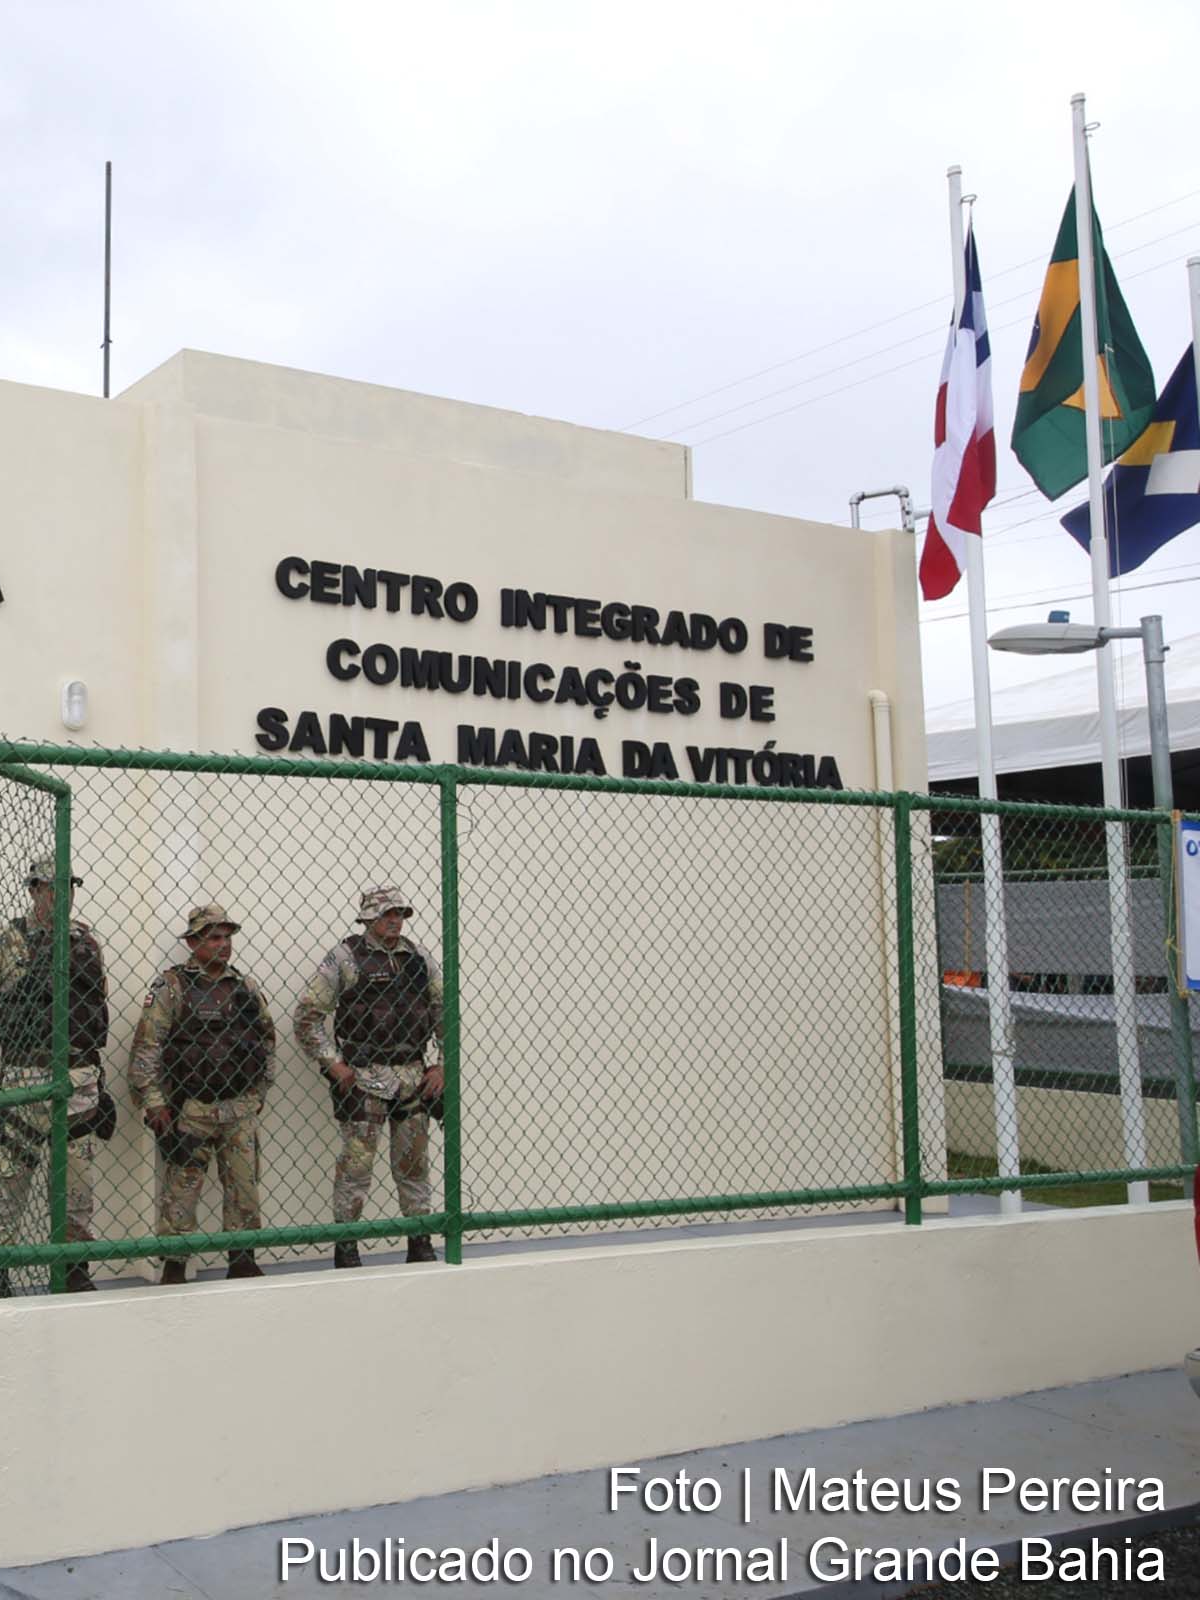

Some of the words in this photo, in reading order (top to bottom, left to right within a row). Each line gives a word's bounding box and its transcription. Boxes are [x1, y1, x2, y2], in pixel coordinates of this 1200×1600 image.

[275, 556, 479, 623] CENTRO
[500, 587, 748, 655] INTEGRADO
[763, 622, 815, 663] DE
[326, 638, 701, 720] COMUNICAÇÕES
[719, 682, 776, 724] DE
[255, 707, 431, 763] SANTA
[456, 724, 607, 776] MARIA
[621, 739, 679, 781] DA
[685, 740, 844, 791] VITÓRIA
